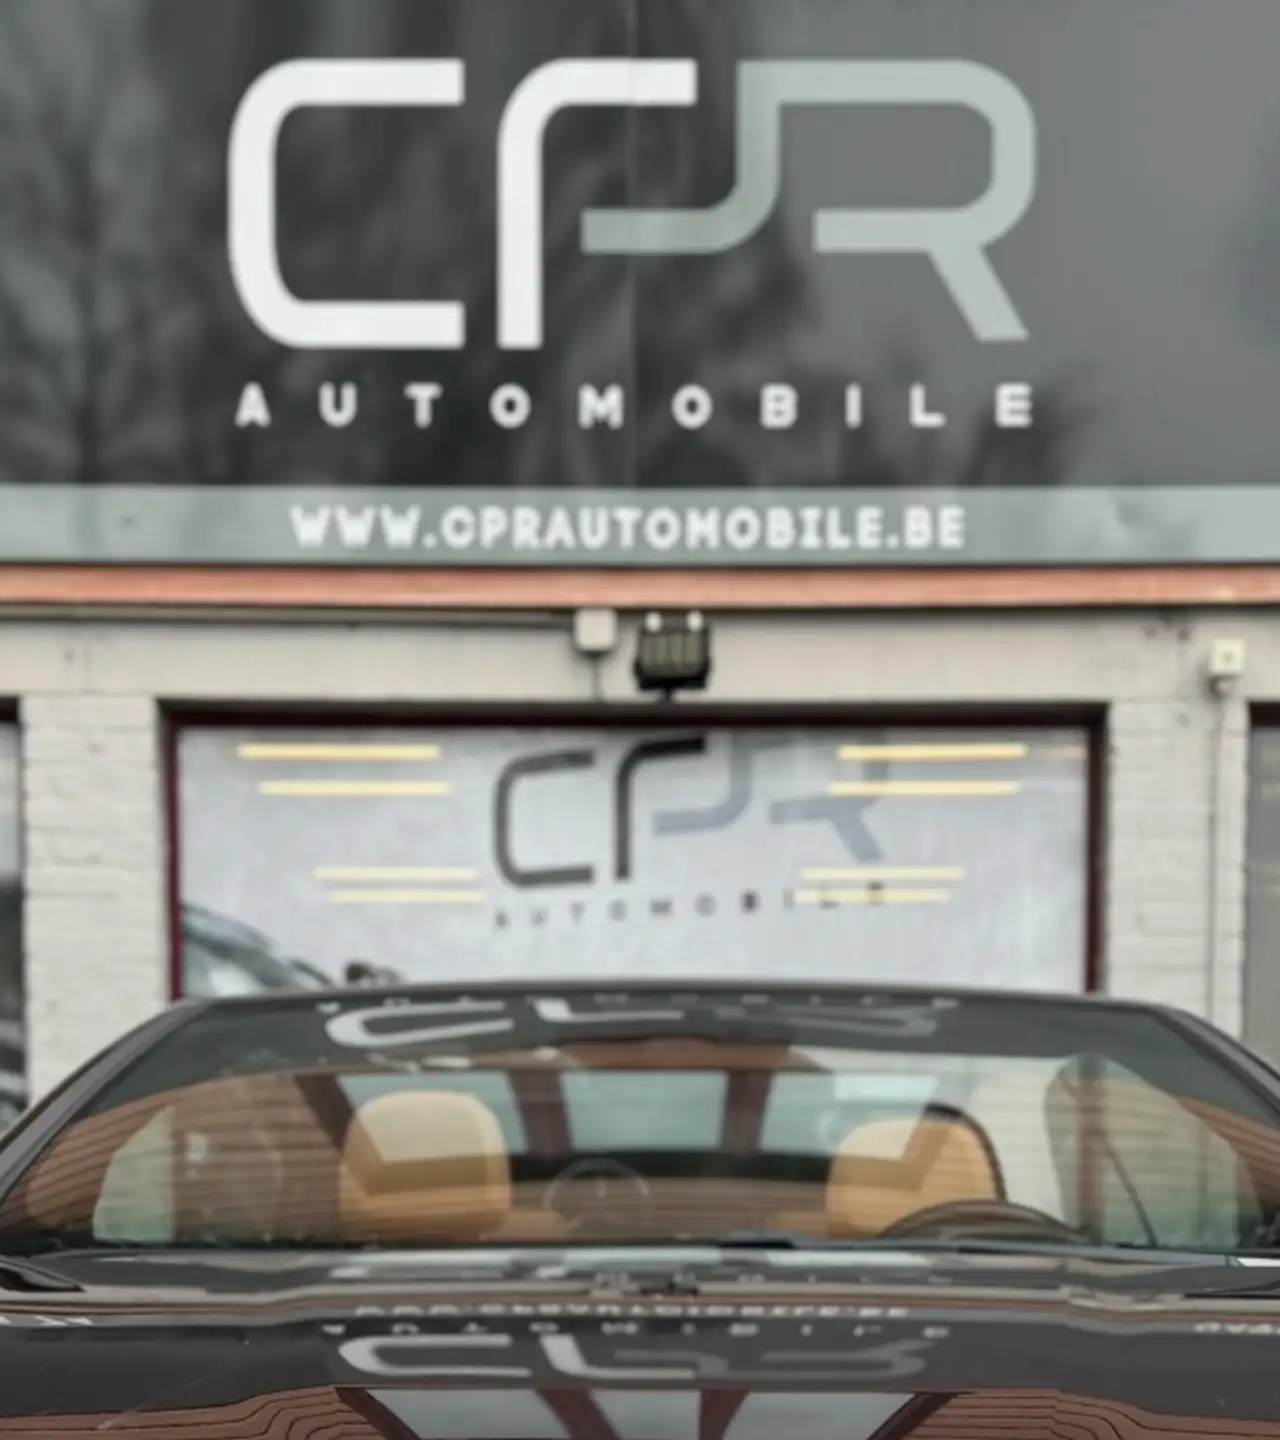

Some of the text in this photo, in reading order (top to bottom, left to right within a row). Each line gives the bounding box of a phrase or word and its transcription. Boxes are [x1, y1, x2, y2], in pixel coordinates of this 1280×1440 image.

[227, 57, 1037, 350] CPR
[235, 381, 1034, 429] AUTOMOBILE
[288, 504, 966, 551] WWW.CPRAUTOMOBILE.BE
[492, 732, 892, 890] CPR
